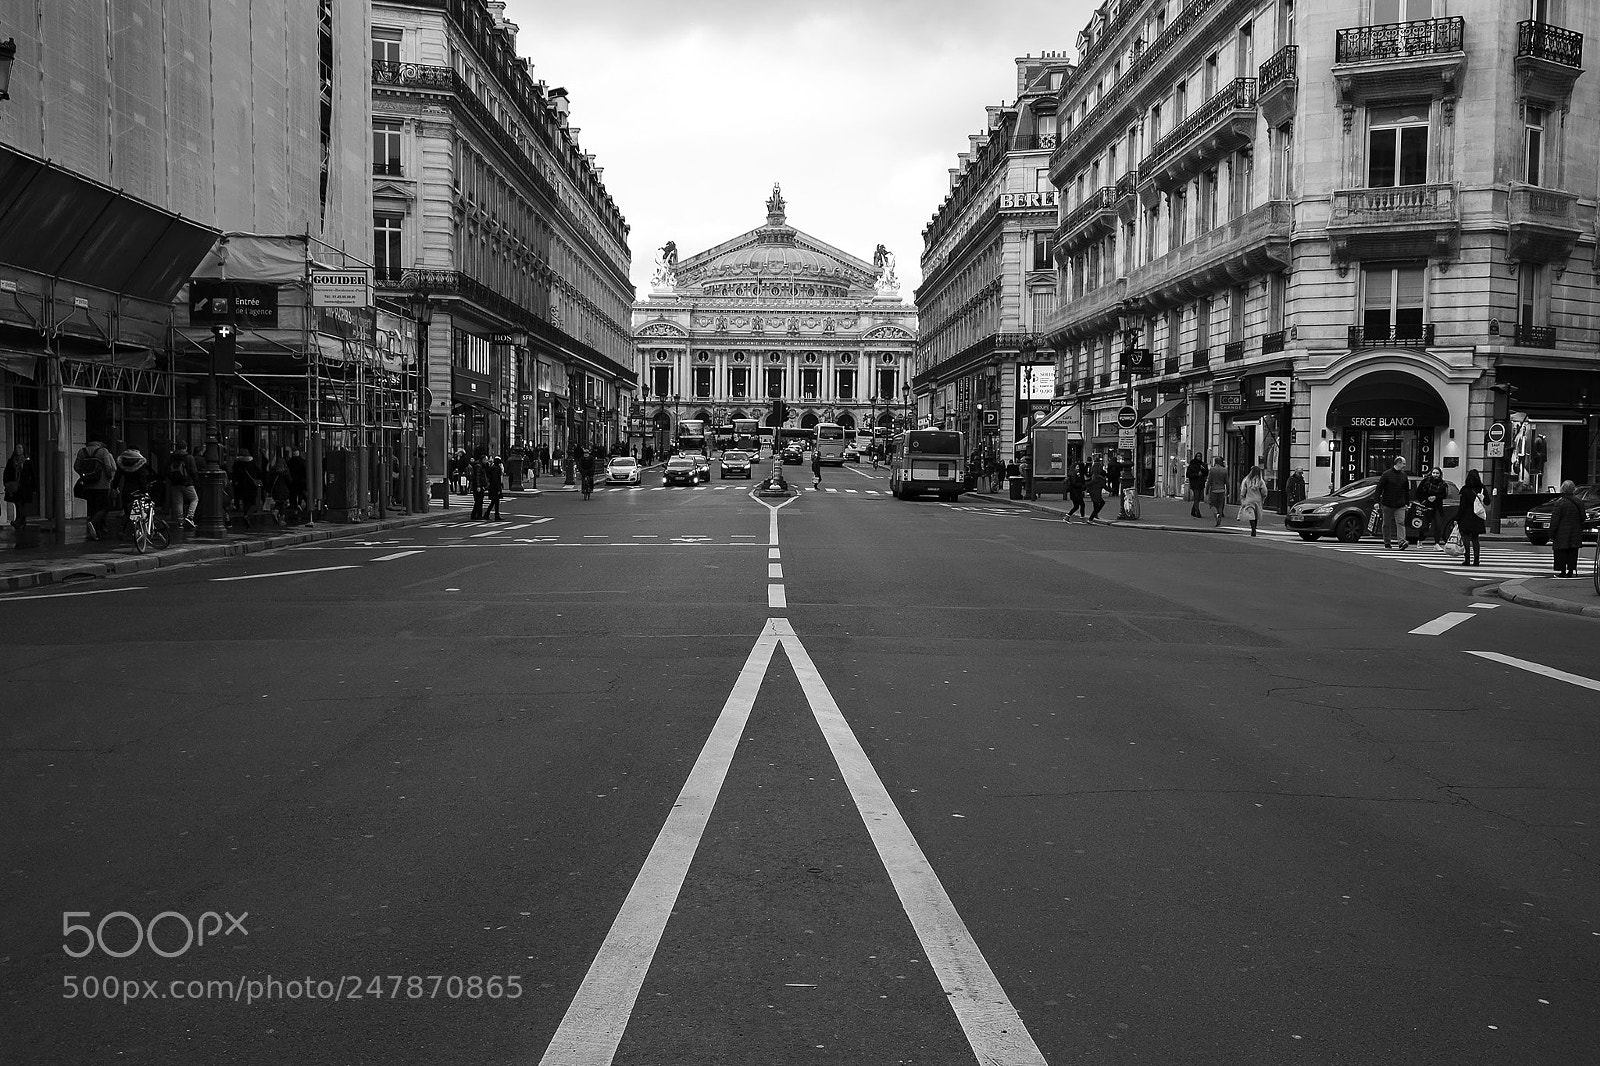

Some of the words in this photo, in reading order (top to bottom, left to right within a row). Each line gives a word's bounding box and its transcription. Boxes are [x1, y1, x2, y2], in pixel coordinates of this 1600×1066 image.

[313, 275, 366, 285] GOUIDER
[235, 297, 260, 306] Entrée
[245, 308, 273, 317] l'agence
[988, 413, 995, 423] P
[1351, 417, 1376, 426] SERGE
[1379, 417, 1415, 426] BLANCO
[1348, 436, 1356, 481] SOLDE
